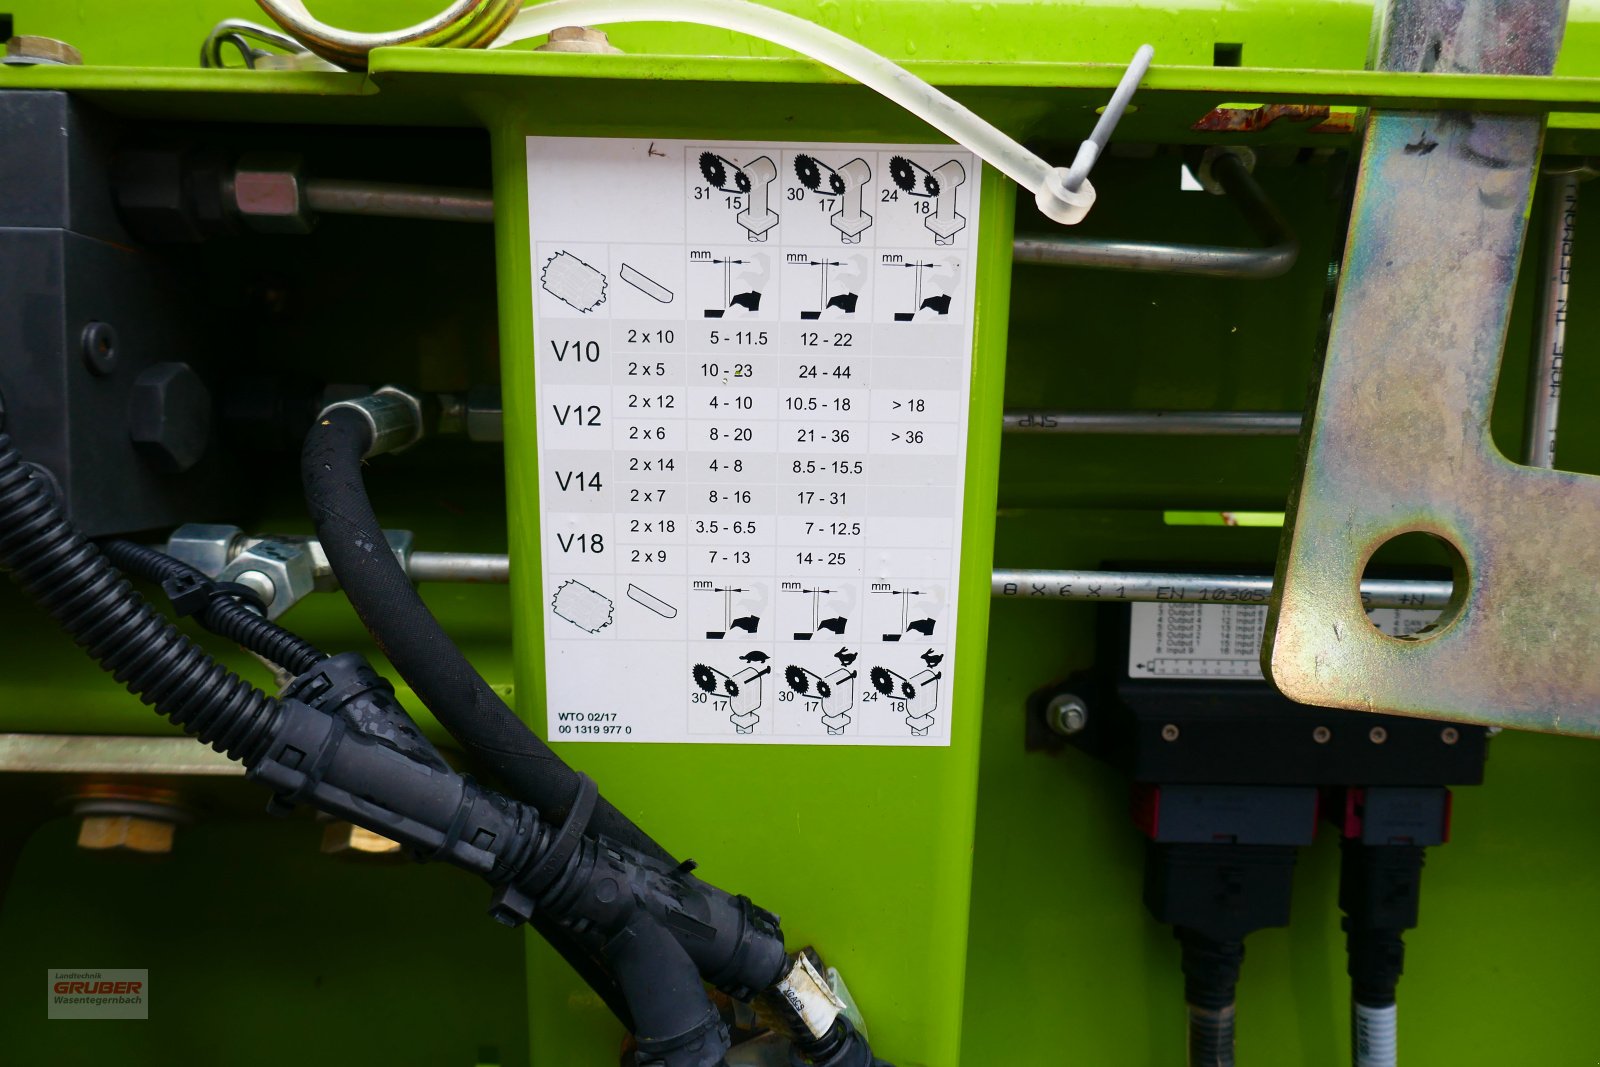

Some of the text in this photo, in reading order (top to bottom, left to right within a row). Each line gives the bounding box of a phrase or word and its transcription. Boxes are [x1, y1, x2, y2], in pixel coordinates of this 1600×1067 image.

[694, 186, 710, 200] 31
[786, 185, 806, 201] 30
[880, 188, 899, 203] 24
[724, 195, 742, 210] 15
[818, 198, 836, 213] 17
[914, 201, 932, 215] 18
[690, 250, 712, 259] mm
[786, 253, 808, 262] mm
[882, 254, 903, 263] mm
[627, 329, 675, 344] 2 x 10
[709, 330, 720, 345] 5
[735, 331, 768, 346] 11.5
[800, 332, 819, 347] 12
[833, 332, 853, 347] 22
[550, 339, 600, 363] V10
[628, 361, 666, 377] 2 x 5
[701, 363, 719, 377] 10
[733, 363, 753, 378] 23
[798, 364, 818, 379] 24
[832, 365, 852, 380] 44
[628, 394, 675, 409] 2 x 12
[709, 395, 719, 410] 4
[735, 395, 753, 410] 10
[785, 396, 818, 411] 10.5
[833, 397, 851, 412] 18
[892, 398, 925, 413] > 18
[552, 404, 602, 427] V12
[629, 425, 666, 441] 2 x 6
[709, 427, 719, 441] 8
[733, 427, 753, 442] 20
[797, 428, 815, 443] 21
[831, 429, 850, 443] 36
[891, 430, 924, 444] > 36
[629, 457, 675, 472] 2 x 14
[708, 458, 719, 472] 4
[733, 459, 743, 473] 8
[792, 460, 816, 474] 8.5
[831, 460, 863, 475] 15.5
[554, 470, 603, 492] V14
[630, 488, 666, 503] 2 x 7
[708, 489, 718, 504] 8
[733, 490, 752, 504] 16
[797, 491, 815, 505] 17
[829, 491, 846, 505] 31
[630, 519, 676, 533] 2 x 18
[695, 520, 719, 534] 3.5
[732, 520, 756, 535] 6.5
[805, 521, 815, 535] 7
[829, 522, 861, 536] 12.5
[556, 532, 605, 554] V18
[631, 549, 667, 563] 2 x 9
[708, 550, 718, 564] 7
[733, 551, 751, 564] 13
[796, 551, 814, 565] 14
[827, 552, 846, 566] 25
[693, 580, 713, 589] mm
[781, 581, 802, 590] mm
[871, 583, 891, 591] mm
[1155, 586, 1185, 600] EN
[691, 689, 709, 704] 30
[778, 688, 796, 702] 30
[862, 688, 880, 703] 24
[712, 700, 728, 712] 17
[804, 701, 820, 713] 17
[889, 700, 905, 713] 18
[557, 712, 617, 722] WTO 02/17
[558, 724, 632, 735] 00 1319 977 0
